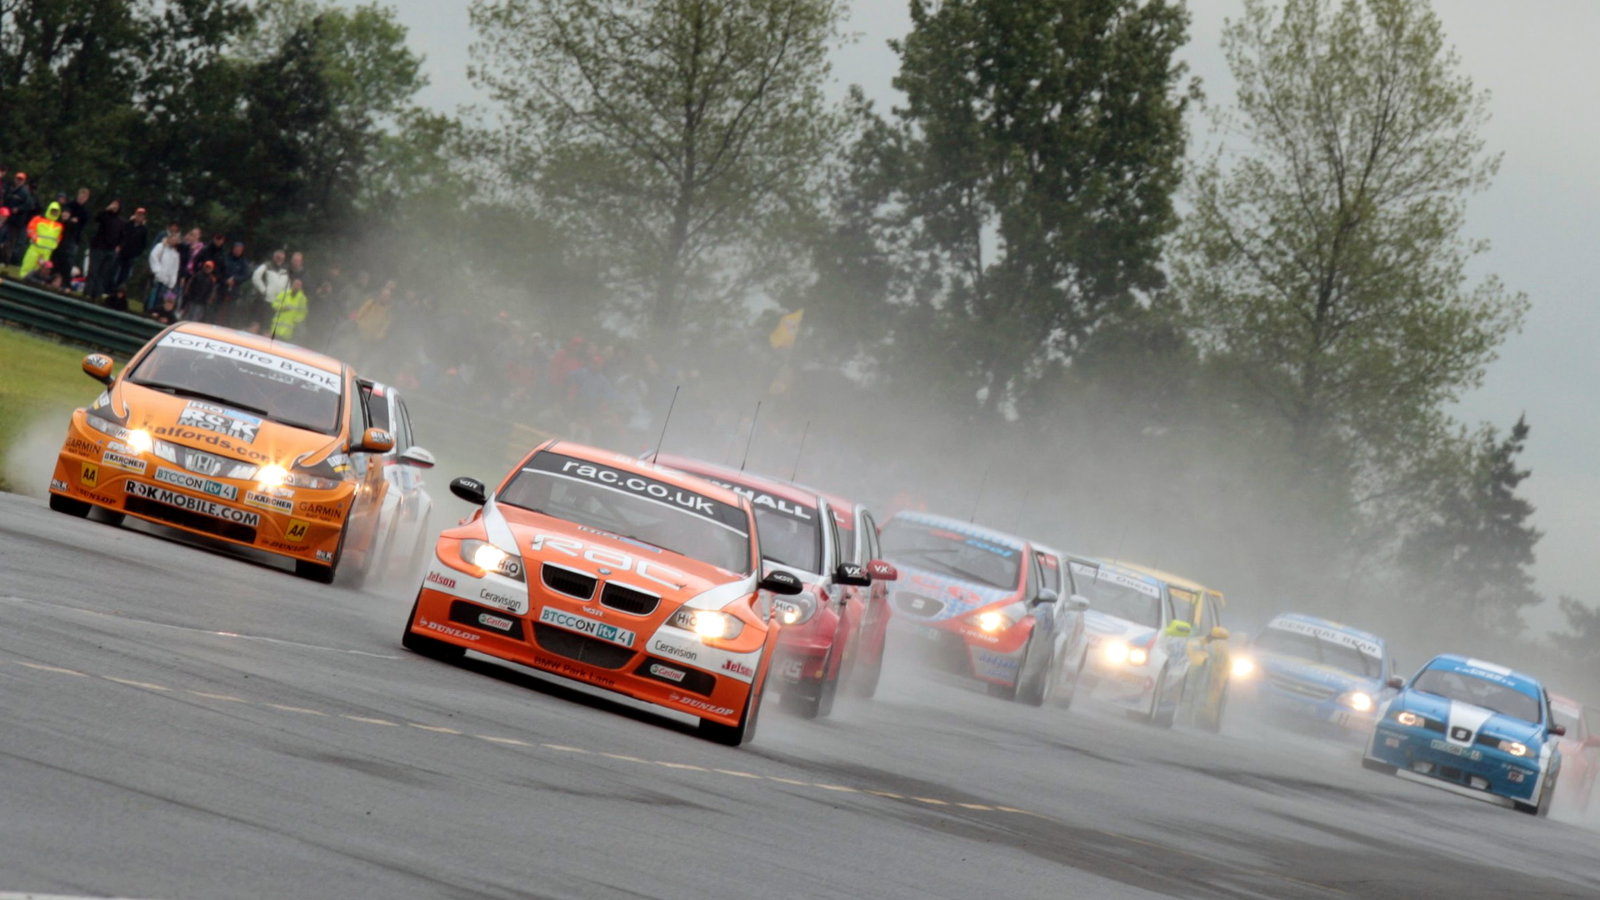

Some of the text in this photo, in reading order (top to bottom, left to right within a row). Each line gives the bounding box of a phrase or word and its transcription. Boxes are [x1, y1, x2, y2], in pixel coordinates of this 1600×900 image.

[169, 335, 273, 365] Yorkshire
[279, 360, 338, 391] Bank
[178, 417, 255, 444] MOBILE
[65, 437, 102, 455] GARMIN
[83, 467, 96, 480] AA
[562, 460, 715, 516] rac.co.uk
[299, 501, 342, 519] GARMIN
[288, 524, 306, 537] AA
[426, 571, 457, 589] Jelson
[480, 588, 522, 610] Ceravision
[427, 621, 481, 641] DUNLOP
[485, 615, 511, 628] Castrol
[654, 640, 697, 661] Ceravision
[563, 661, 588, 677] Park
[588, 671, 616, 685] Lane
[658, 665, 684, 680] Castrol
[679, 696, 735, 716] DUNLOP
